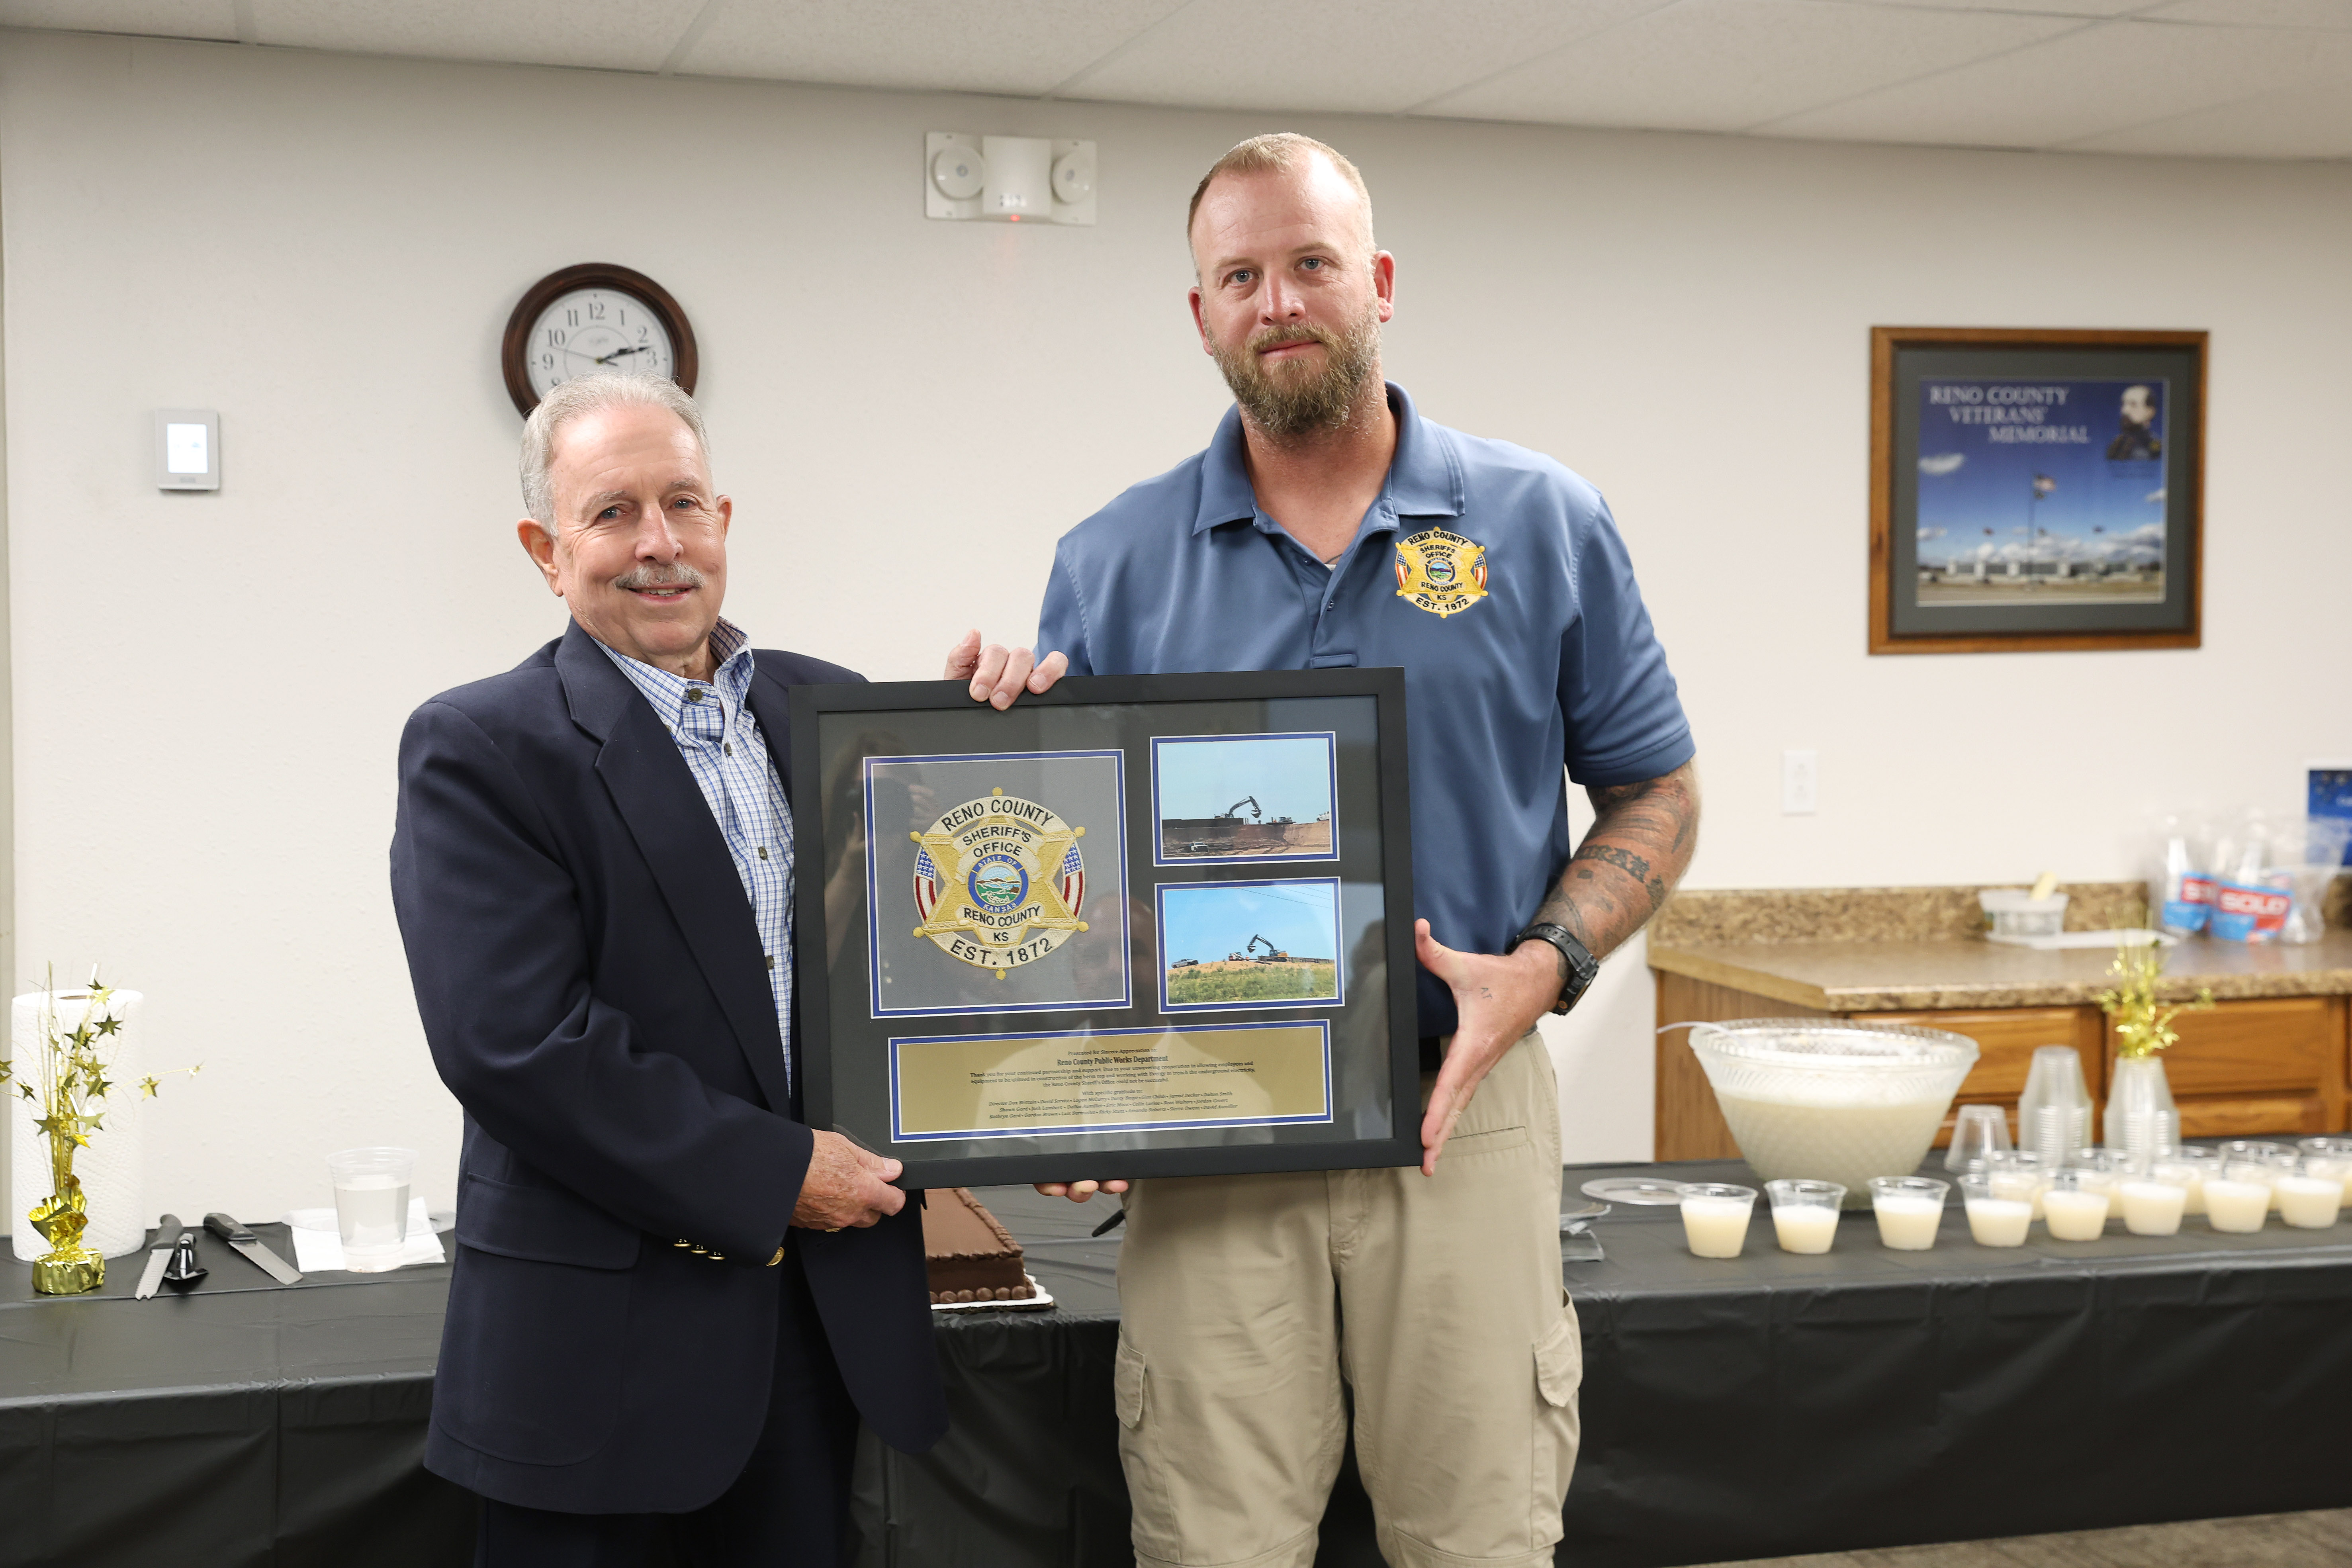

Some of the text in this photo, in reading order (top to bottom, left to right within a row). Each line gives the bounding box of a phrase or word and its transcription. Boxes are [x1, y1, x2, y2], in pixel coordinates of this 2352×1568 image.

[567, 309, 579, 327] 11
[589, 302, 605, 319] 12
[620, 309, 625, 326] 1
[548, 329, 565, 346] 10
[637, 327, 648, 343] 2
[542, 353, 554, 370] 9
[647, 350, 657, 366] 3
[1930, 386, 2070, 405] RENO COUNTY
[1989, 425, 2091, 444] MEMORIAL
[1408, 531, 1468, 546] RENO COUNTY
[1421, 582, 1438, 591] RENO
[1440, 582, 1463, 592] COUNTY
[1416, 597, 1470, 611] EST. 1872
[941, 799, 1053, 831] RENO COUNTY
[963, 826, 1031, 846] SHERIFF'S
[973, 842, 1022, 857] OFFICE
[978, 856, 1017, 868] STATE OF
[983, 902, 1017, 912] KANSAS
[964, 906, 1040, 927] RENO COUNTY
[994, 932, 1008, 942] KS
[951, 938, 1053, 965] EST. 1872
[1133, 1055, 1168, 1064] Department
